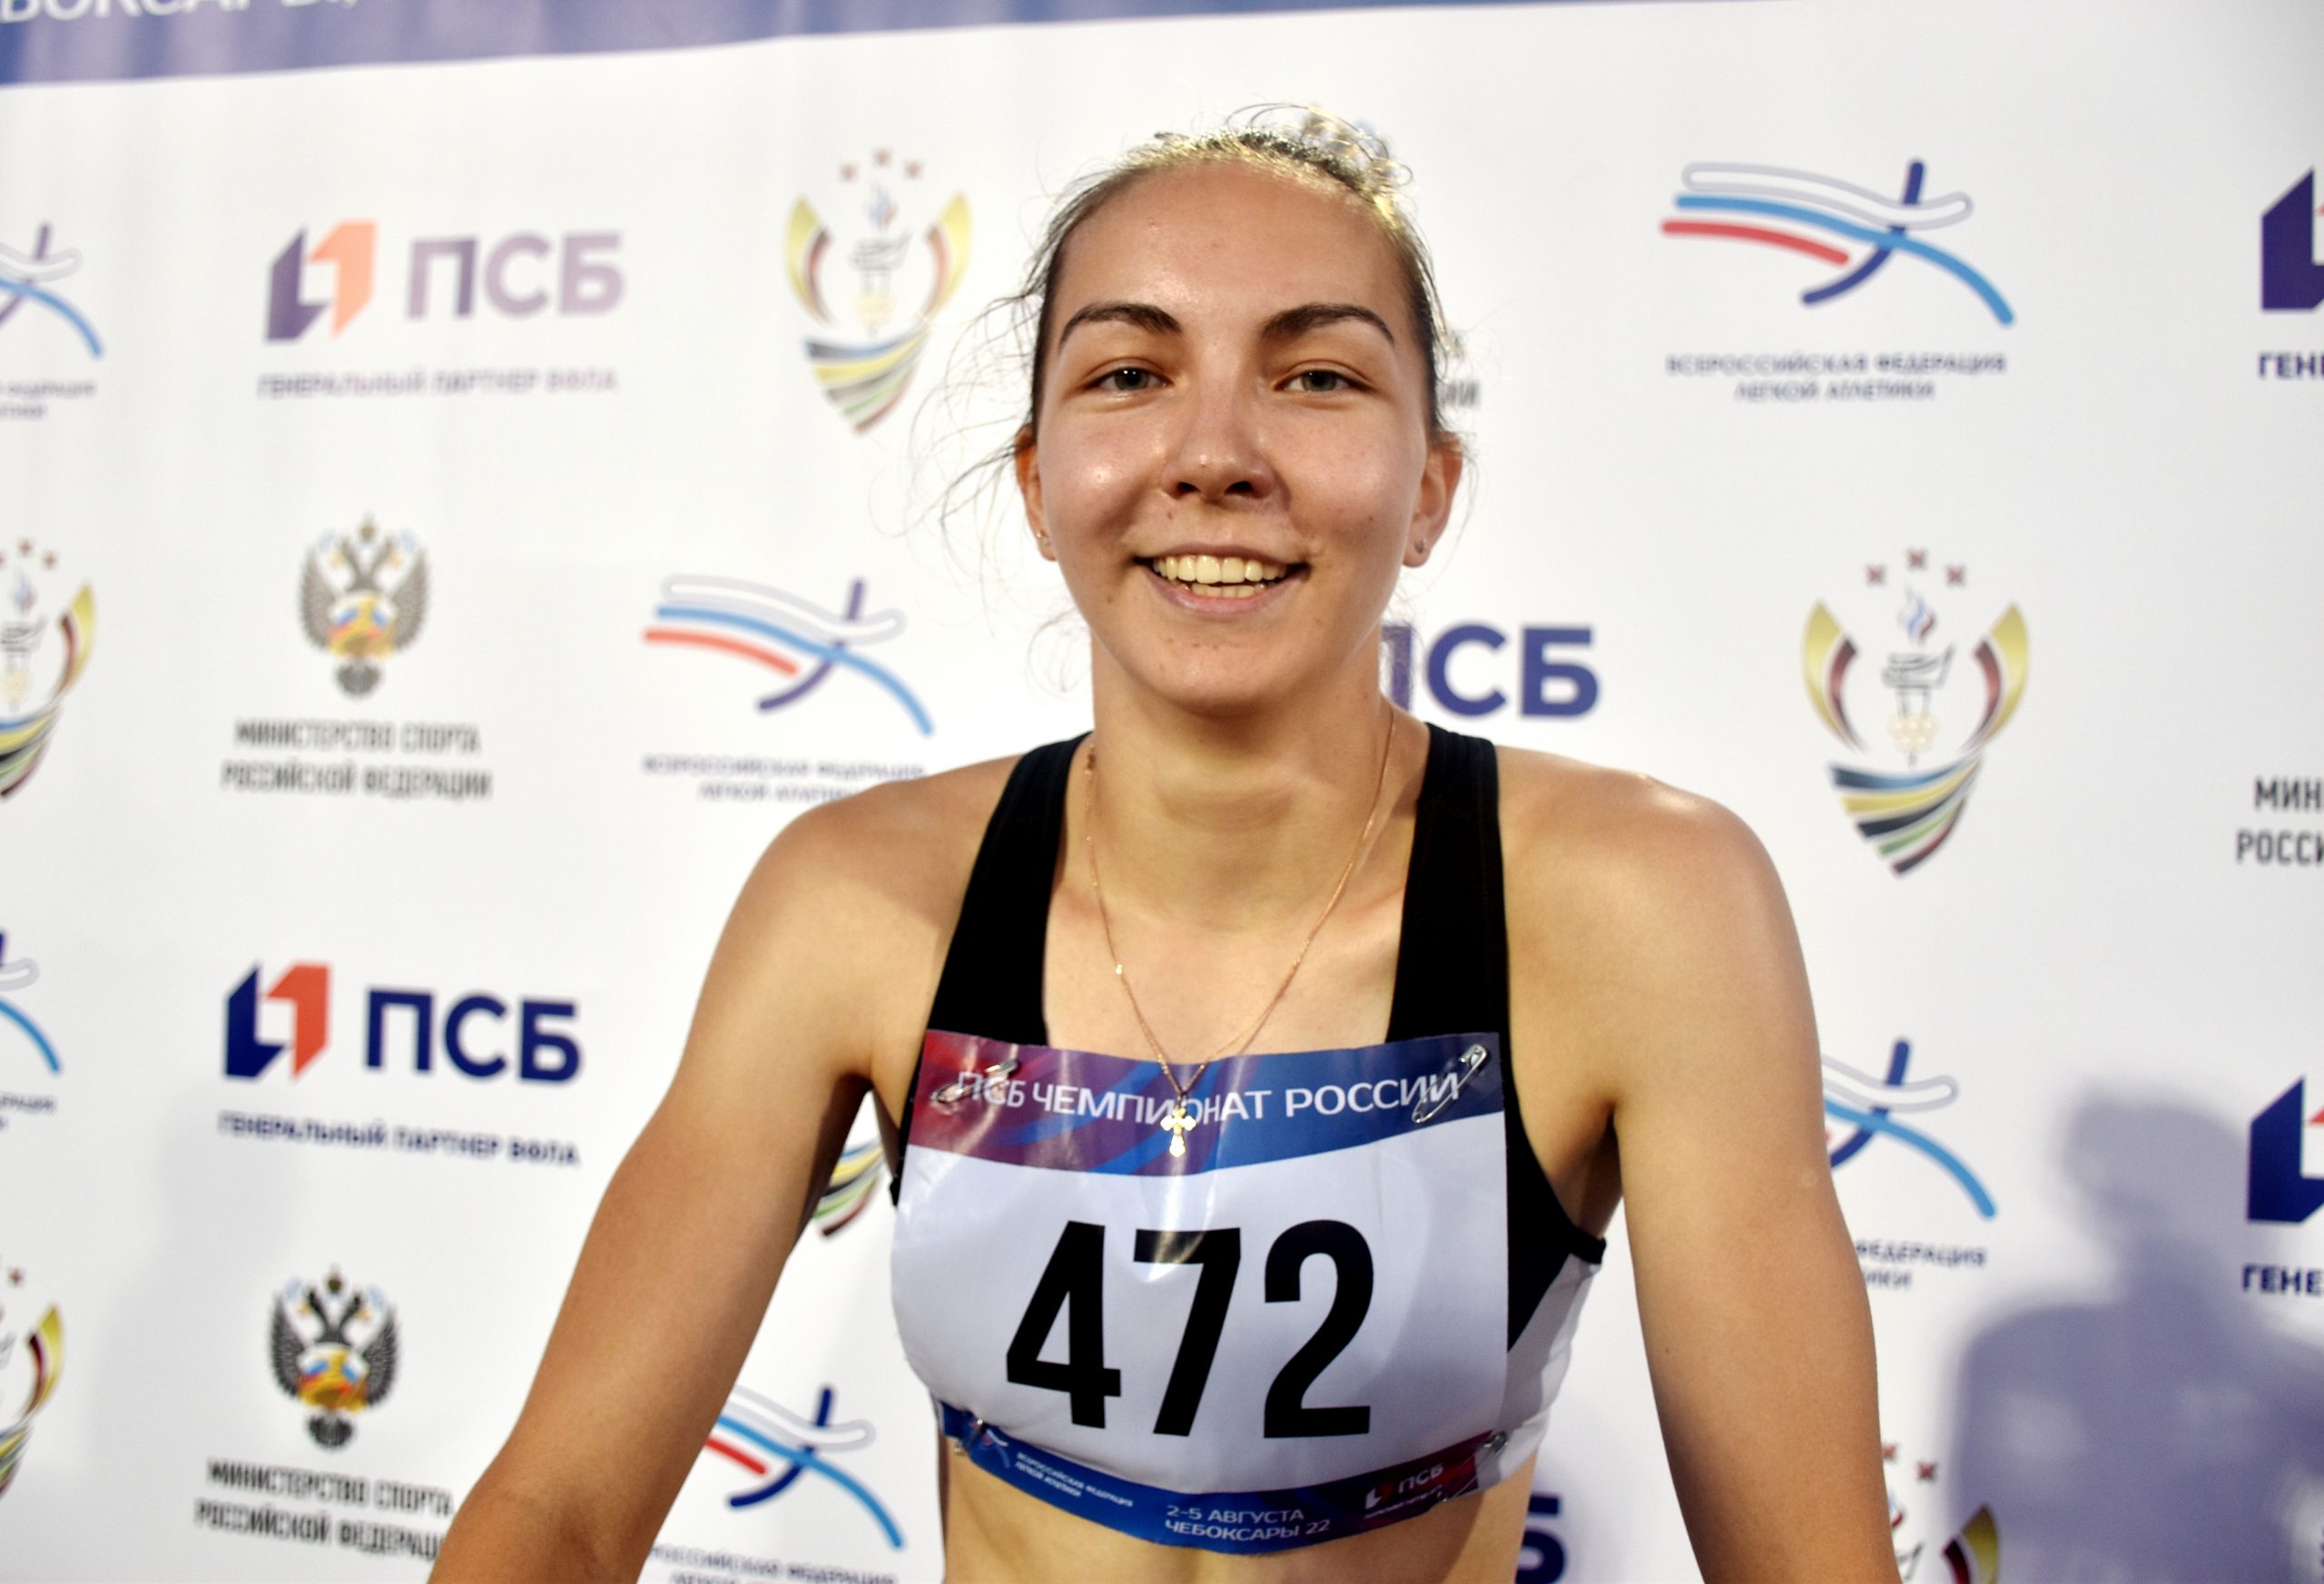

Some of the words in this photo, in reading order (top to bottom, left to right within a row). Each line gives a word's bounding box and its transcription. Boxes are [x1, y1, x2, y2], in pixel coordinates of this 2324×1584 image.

[407, 231, 625, 319] ПСБ
[2258, 351, 2324, 380] ГЕН
[367, 989, 582, 1082] ПСБ
[1032, 1082, 1271, 1125] ЧЕМПИОНАТ
[1285, 1072, 1460, 1117] РОССИИ
[1007, 1220, 1374, 1438] 472
[206, 1457, 369, 1508] МИНИСТЕРСТВО
[373, 1479, 453, 1519] СПОРТА
[1398, 1461, 1444, 1494] ПСБ
[192, 1497, 332, 1546] РОССИЙСКОЙ
[1165, 1519, 1301, 1542] ЧЕБОКСАРЫ
[1305, 1519, 1332, 1535] 22
[1166, 1505, 1203, 1520] 2-5
[1207, 1509, 1305, 1525] АВГУСТА
